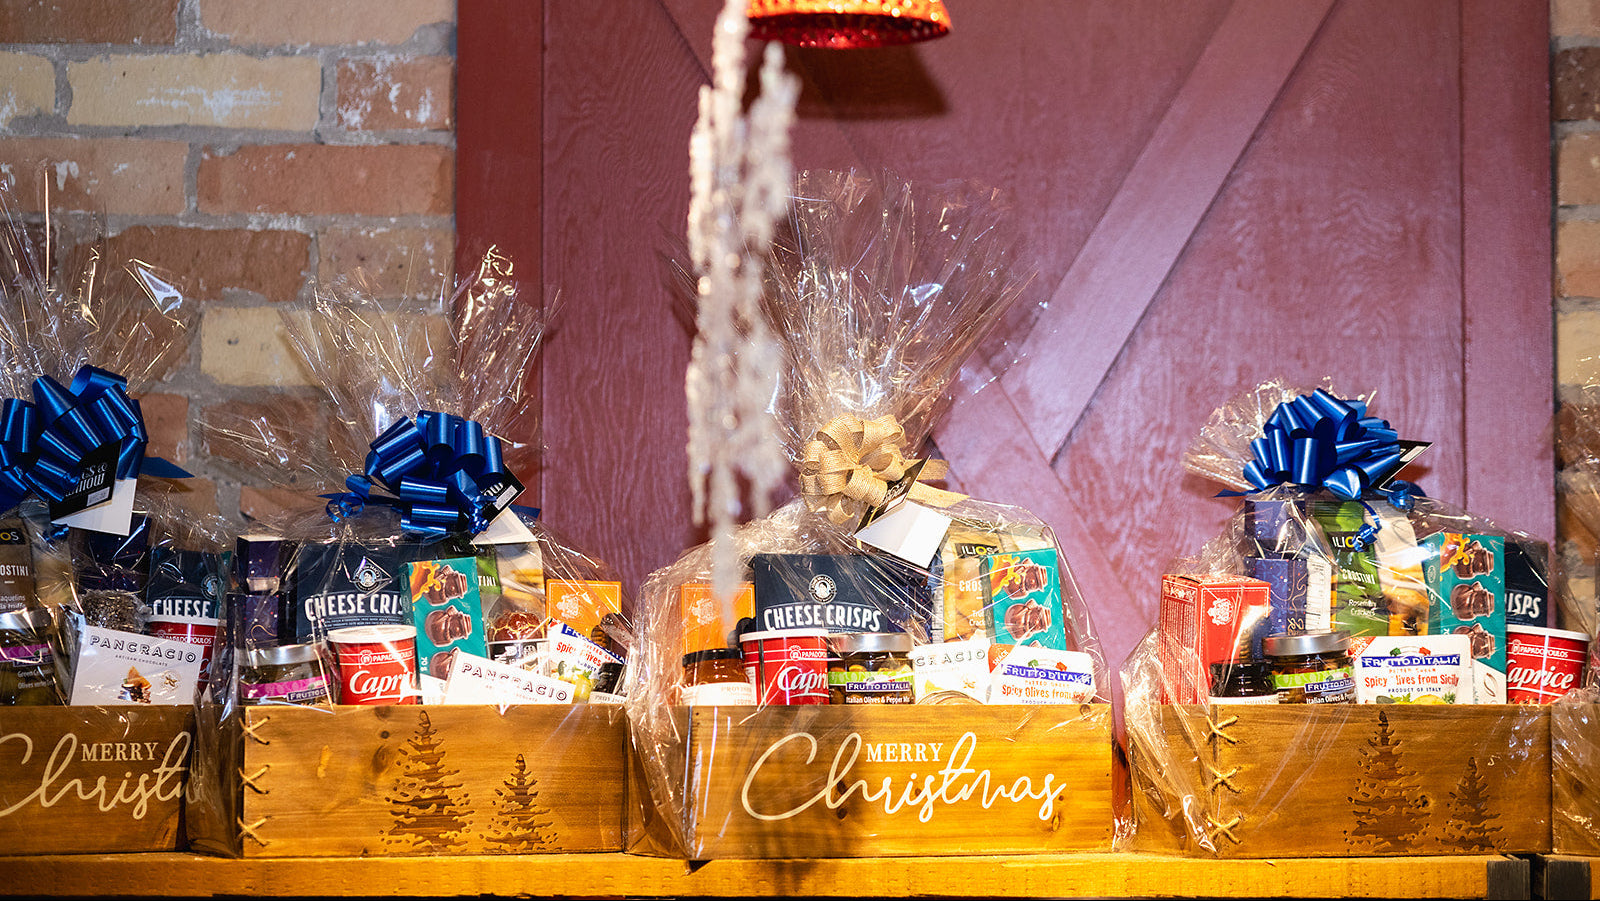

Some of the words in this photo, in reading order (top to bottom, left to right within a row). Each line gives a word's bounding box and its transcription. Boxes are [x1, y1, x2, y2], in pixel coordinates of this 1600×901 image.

[961, 545, 995, 556] ILIOS
[0, 564, 29, 577] OSTINI
[477, 575, 497, 587] TINI
[153, 599, 211, 618] CHEESE
[304, 592, 365, 622] CHEESE
[1506, 593, 1542, 619] ISPS
[763, 604, 823, 631] CHEESE
[826, 604, 882, 633] CRISPS
[89, 635, 197, 663] PANCRACIO
[916, 649, 987, 667] CRACIO
[1004, 665, 1046, 678] FRUTTO
[1364, 676, 1388, 689] Spicy
[1390, 675, 1416, 687] lives
[1418, 674, 1438, 685] from
[1440, 673, 1460, 688] Sicily
[864, 696, 880, 704] Olives
[1002, 684, 1024, 697] Spicy
[1025, 685, 1050, 698] Olives
[1052, 688, 1071, 699] from
[81, 742, 158, 762] MERRY
[866, 742, 943, 763] MERRY
[741, 731, 1067, 823] Christmas
